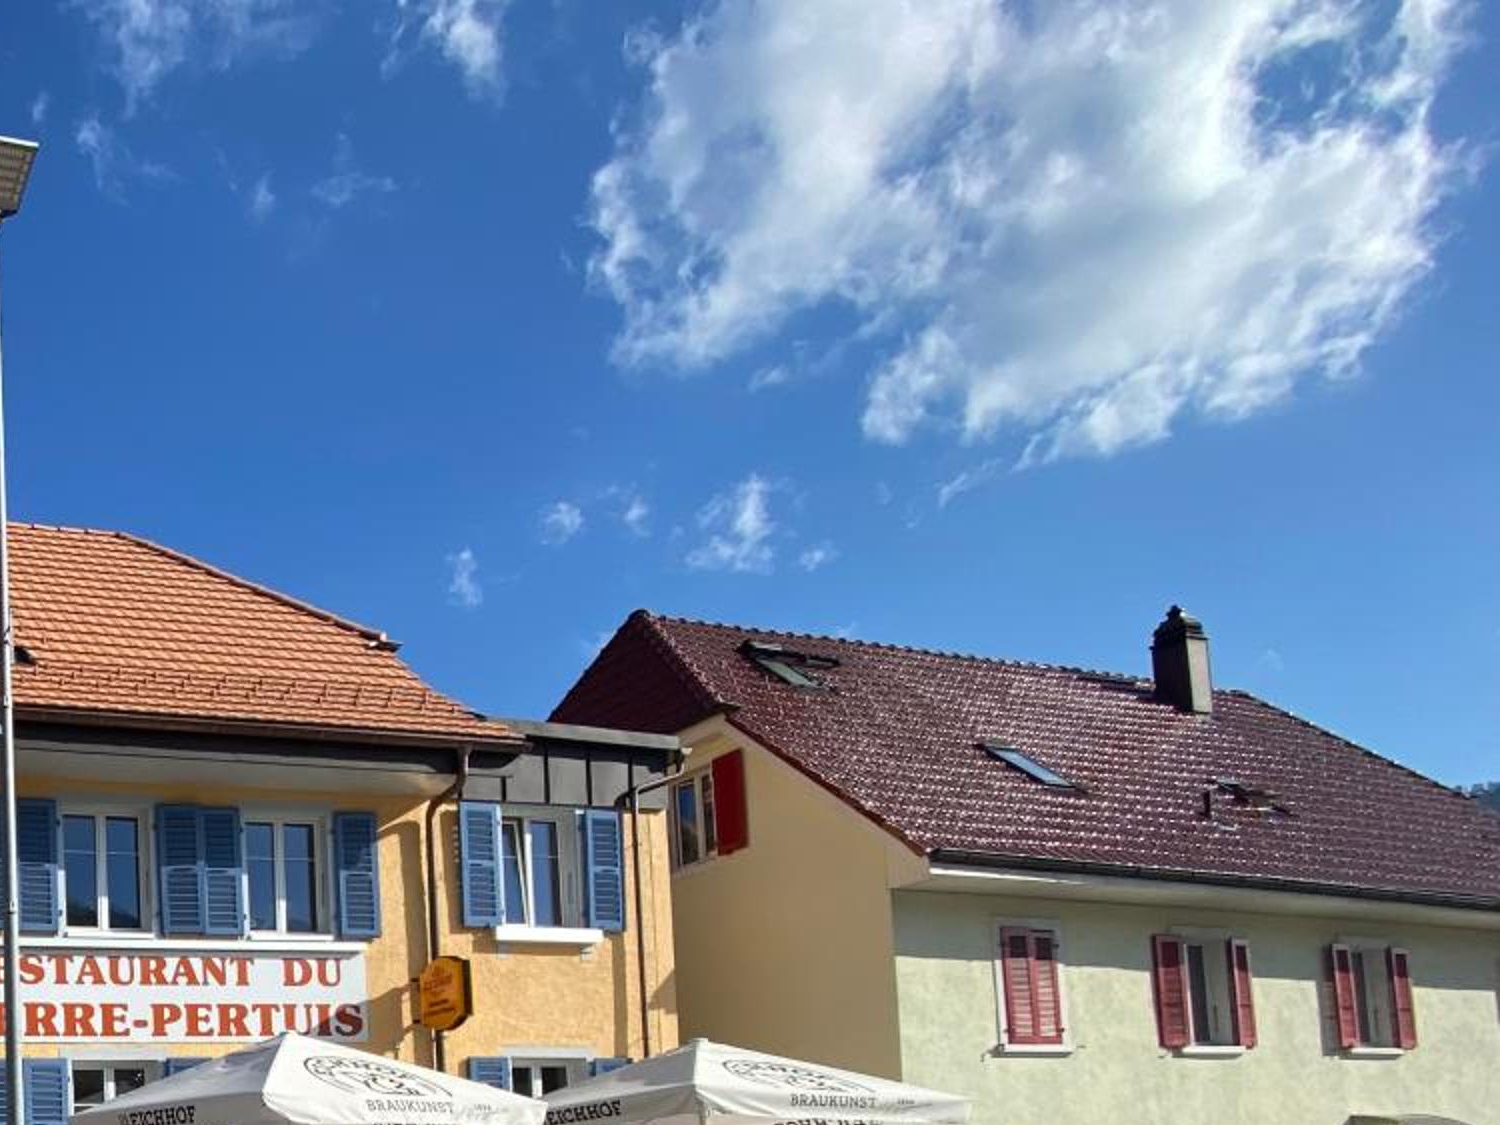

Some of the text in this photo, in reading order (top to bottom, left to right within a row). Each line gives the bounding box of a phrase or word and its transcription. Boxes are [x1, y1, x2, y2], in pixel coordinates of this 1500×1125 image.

[282, 957, 342, 987] DU
[366, 1098, 453, 1115] BRAUKUNST
[790, 1093, 878, 1109] BRAUKUNST
